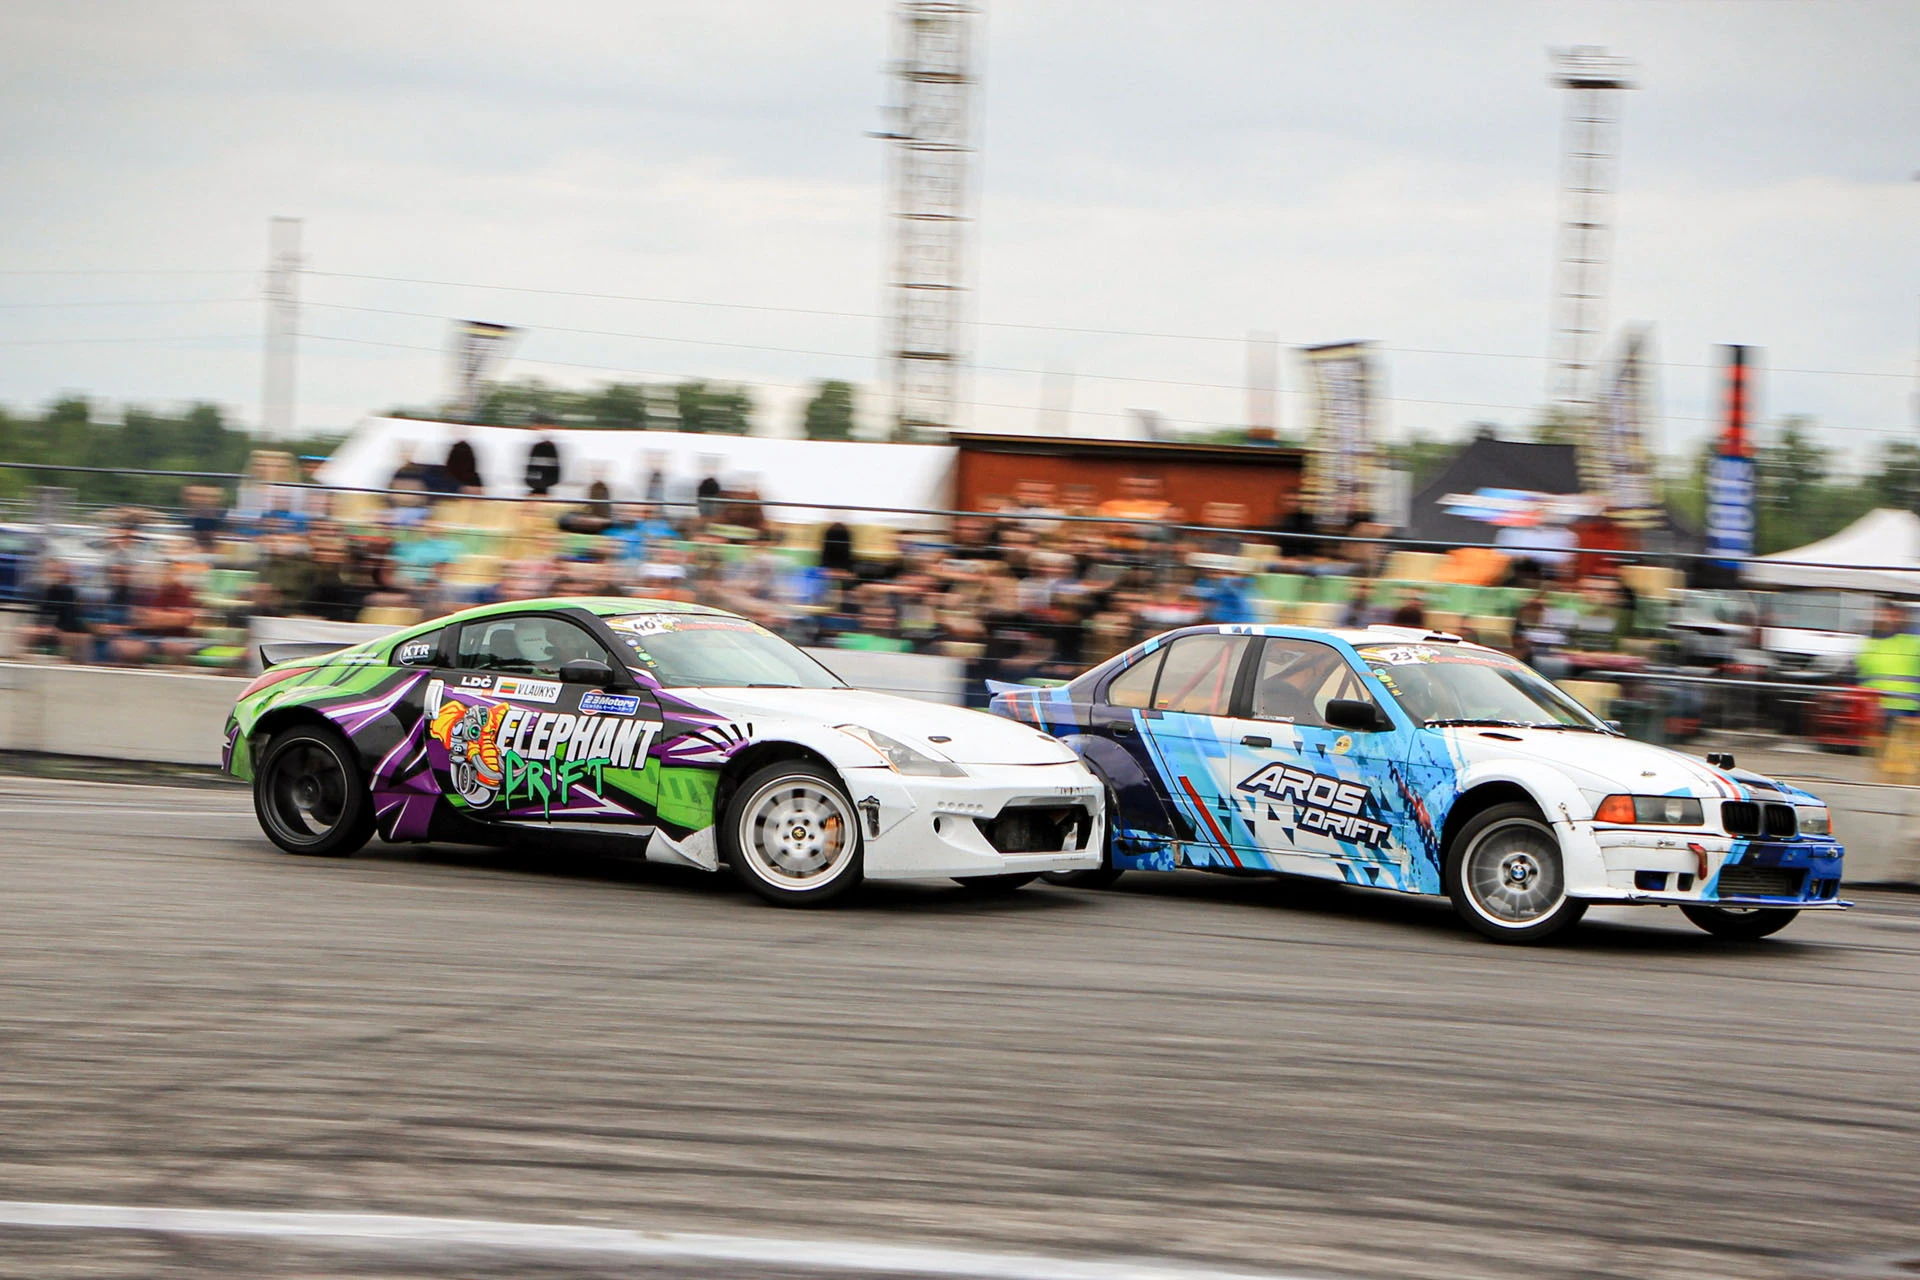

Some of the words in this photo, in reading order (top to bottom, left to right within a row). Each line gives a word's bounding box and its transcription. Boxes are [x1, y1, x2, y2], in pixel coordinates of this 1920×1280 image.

[633, 621, 656, 631] 40
[403, 644, 430, 657] KTR
[1389, 651, 1413, 661] 23
[461, 675, 492, 688] LDČ
[517, 683, 557, 698] V.LAUKYS
[584, 695, 636, 707] 23Motors
[496, 710, 663, 769] ELEPHANT
[506, 749, 611, 819] DRIFT
[1244, 764, 1368, 815] AROS
[1301, 808, 1389, 844] DRIFT
